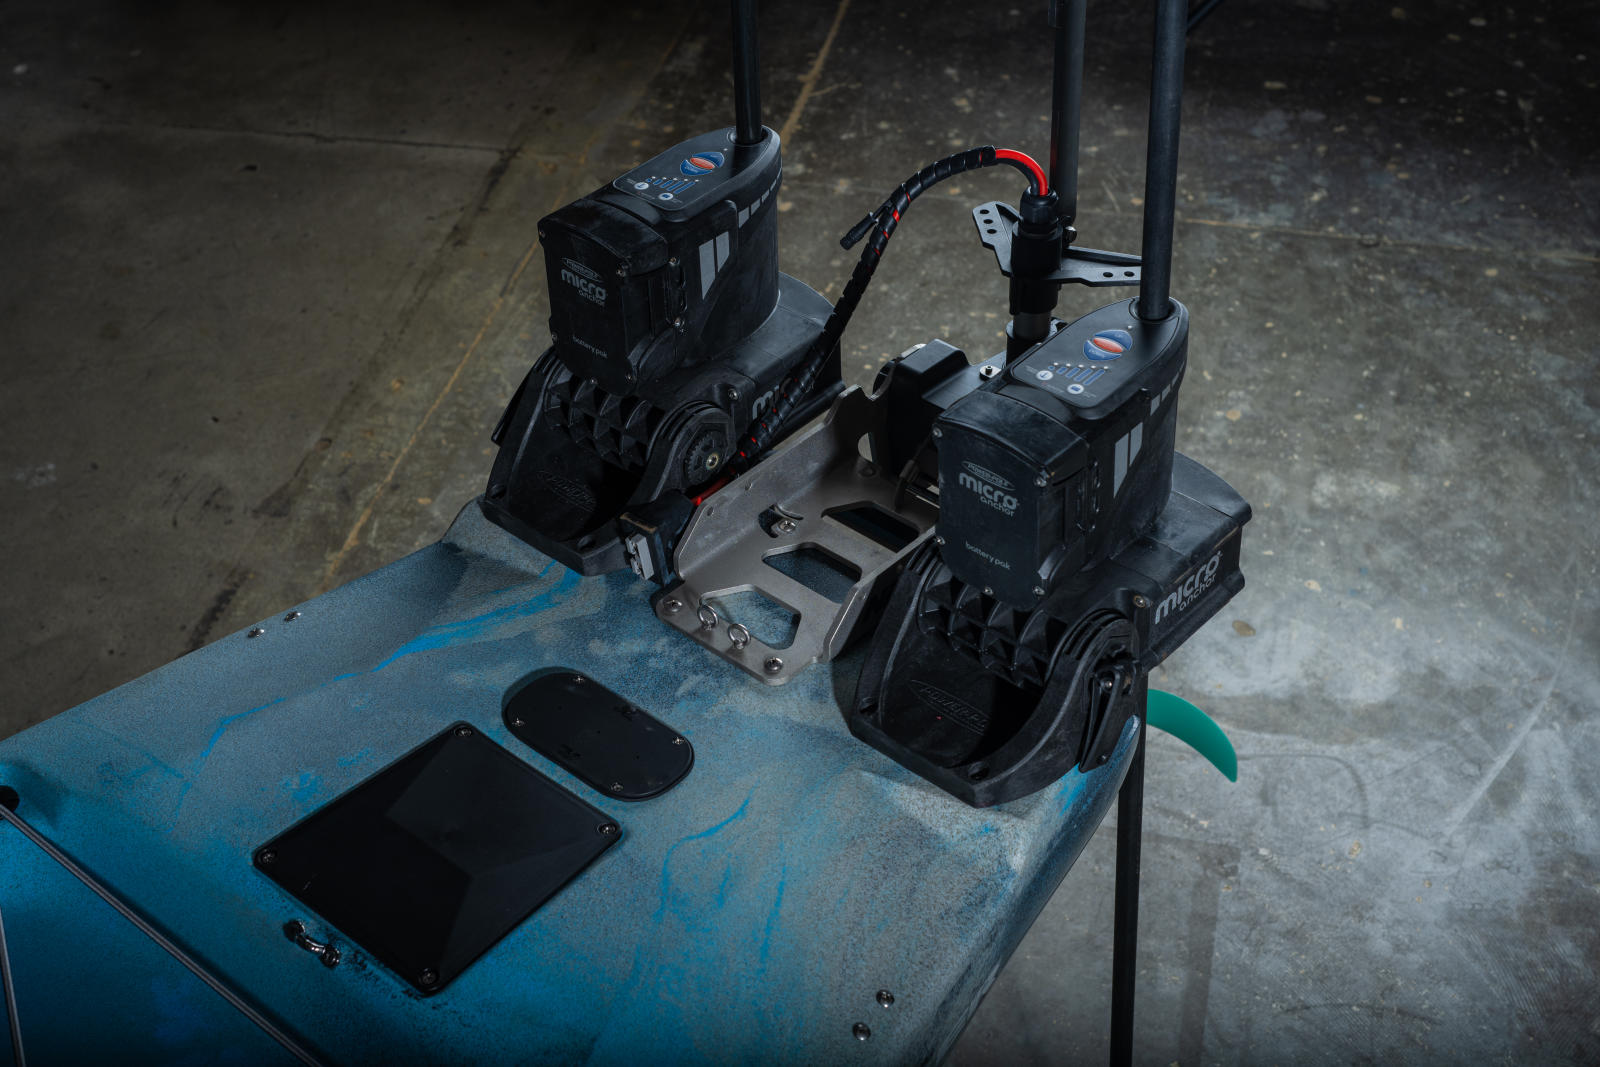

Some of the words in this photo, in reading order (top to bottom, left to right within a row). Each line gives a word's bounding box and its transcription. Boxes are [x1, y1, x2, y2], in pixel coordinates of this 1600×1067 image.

[561, 268, 607, 301] micro
[959, 472, 1018, 511] micro
[980, 496, 1015, 518] anchor
[1155, 553, 1220, 625] micro
[1179, 573, 1217, 612] anchor
